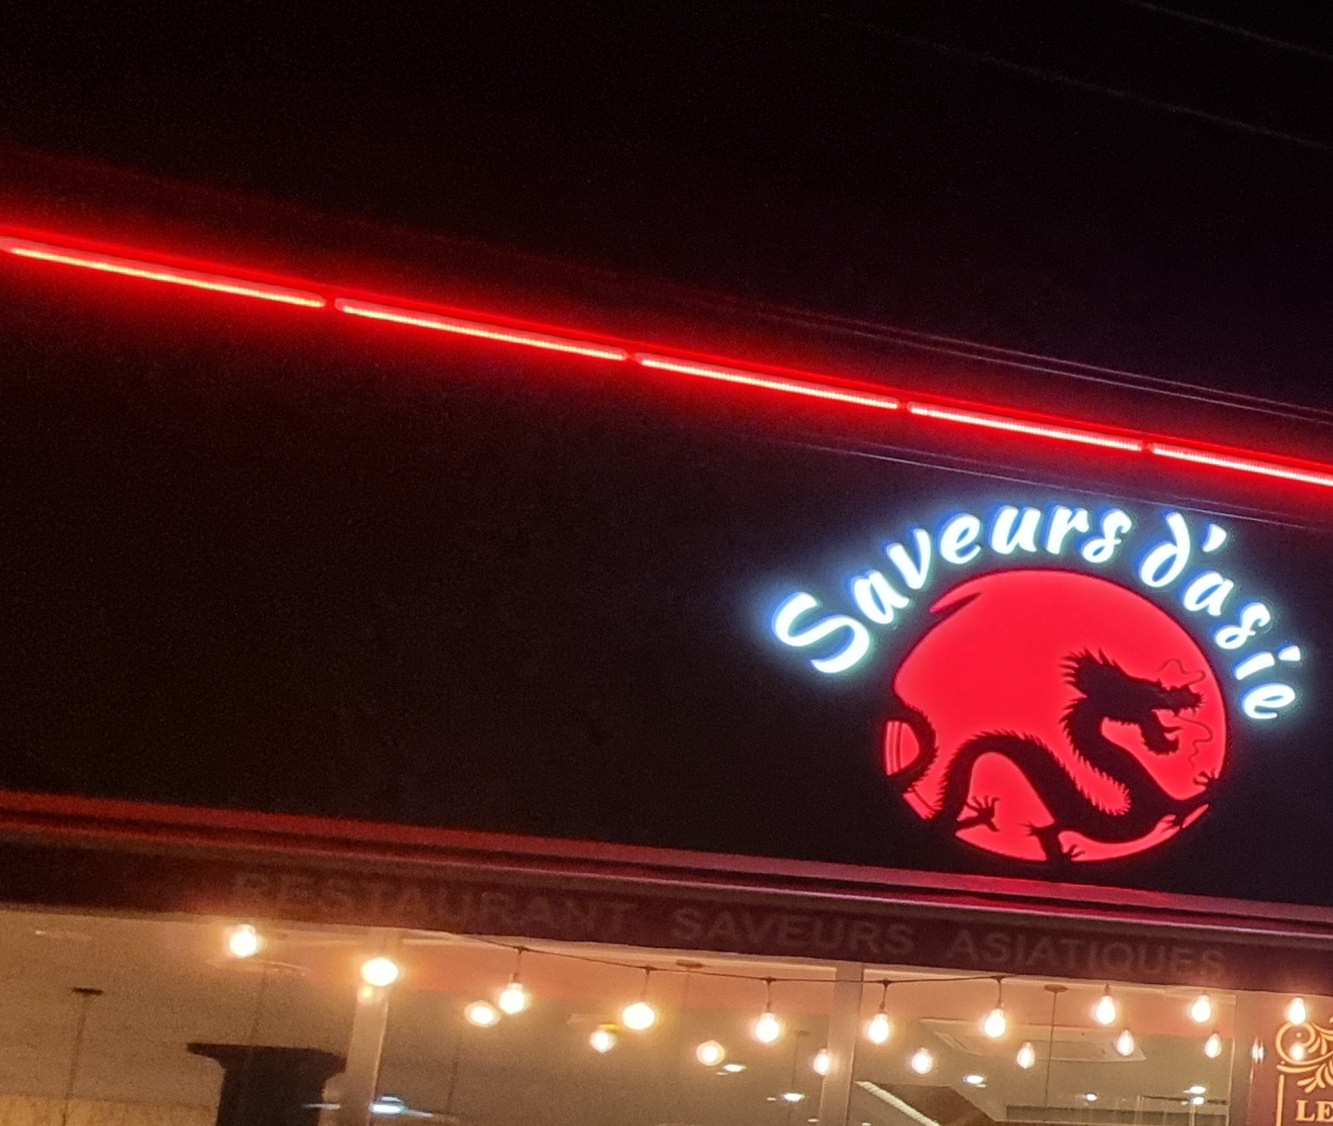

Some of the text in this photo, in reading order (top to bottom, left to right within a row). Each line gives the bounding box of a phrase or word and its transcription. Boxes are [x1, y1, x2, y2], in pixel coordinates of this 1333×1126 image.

[774, 505, 1301, 720] Saveurs d'asie
[231, 872, 1229, 979] RESTAURANT SAVEURS ASIATIQUES
